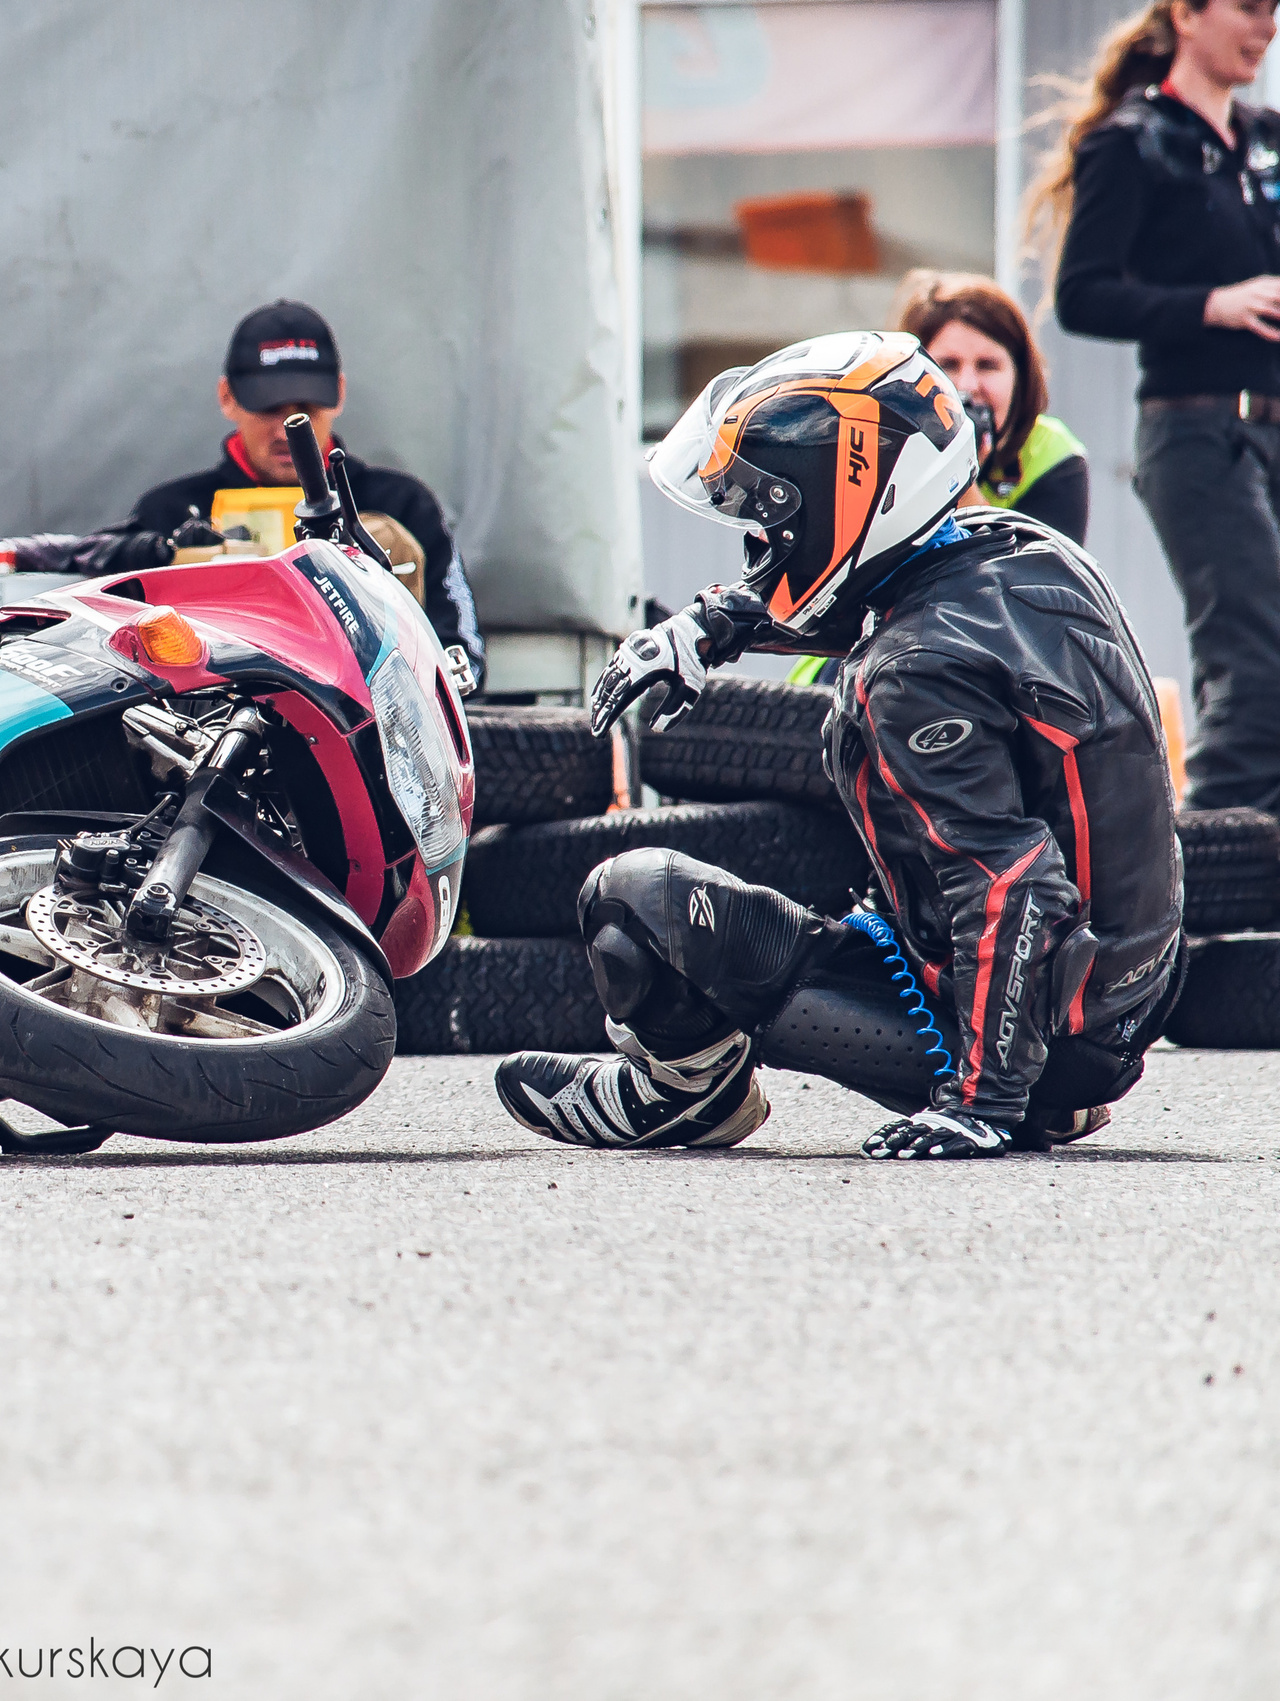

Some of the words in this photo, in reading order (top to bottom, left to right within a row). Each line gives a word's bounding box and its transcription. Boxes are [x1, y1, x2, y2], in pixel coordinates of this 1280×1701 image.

[847, 426, 870, 487] HJC
[313, 576, 360, 635] JETFIRE
[996, 887, 1041, 1071] AGVSPORT
